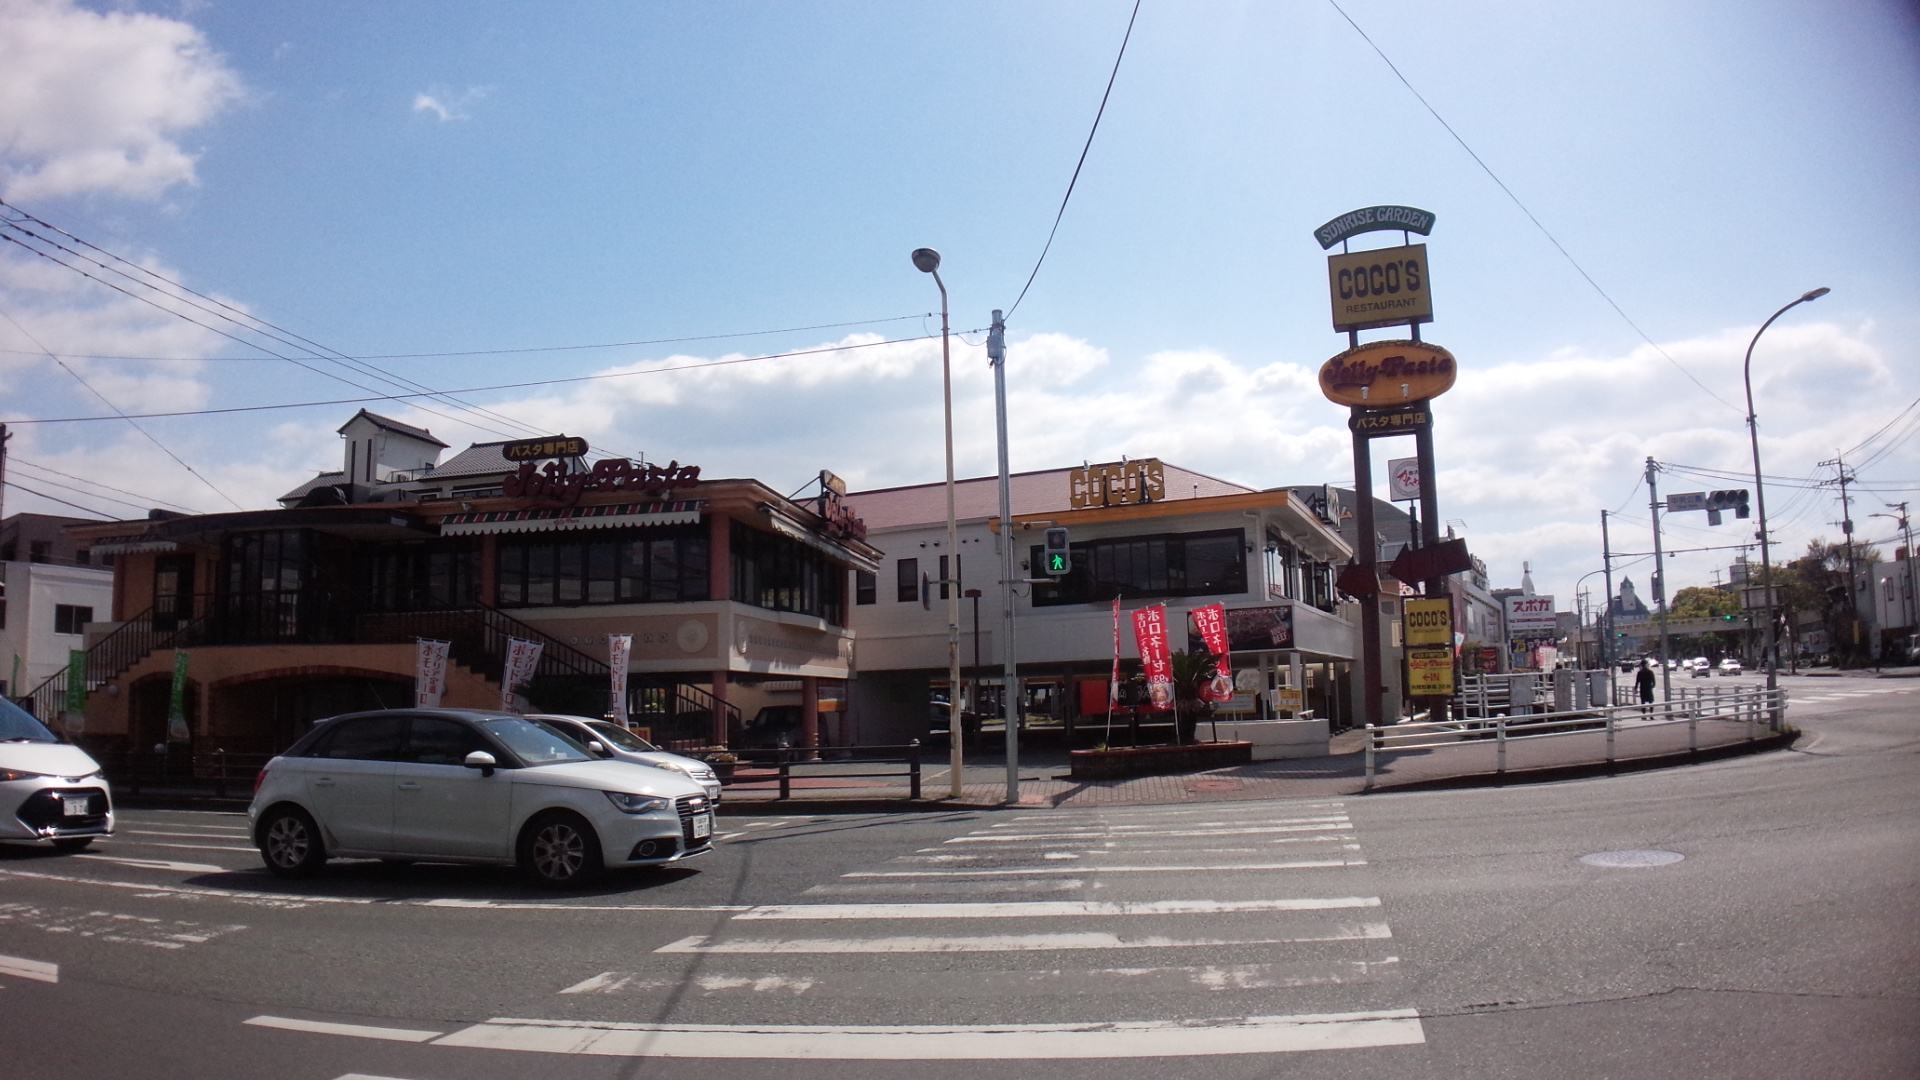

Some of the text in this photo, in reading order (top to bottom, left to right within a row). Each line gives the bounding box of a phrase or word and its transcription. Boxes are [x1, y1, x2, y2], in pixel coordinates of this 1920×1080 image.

[1321, 207, 1429, 243] SUNRISE GARDEN
[1338, 259, 1421, 300] COCO'S
[1346, 298, 1417, 314] RESTAURANT
[1356, 412, 1426, 429] パスタ専門店
[510, 440, 579, 457] パスタ専門店
[1070, 460, 1165, 508] COCO'S
[1409, 610, 1447, 627] COCO'S
[1430, 673, 1440, 682] IN
